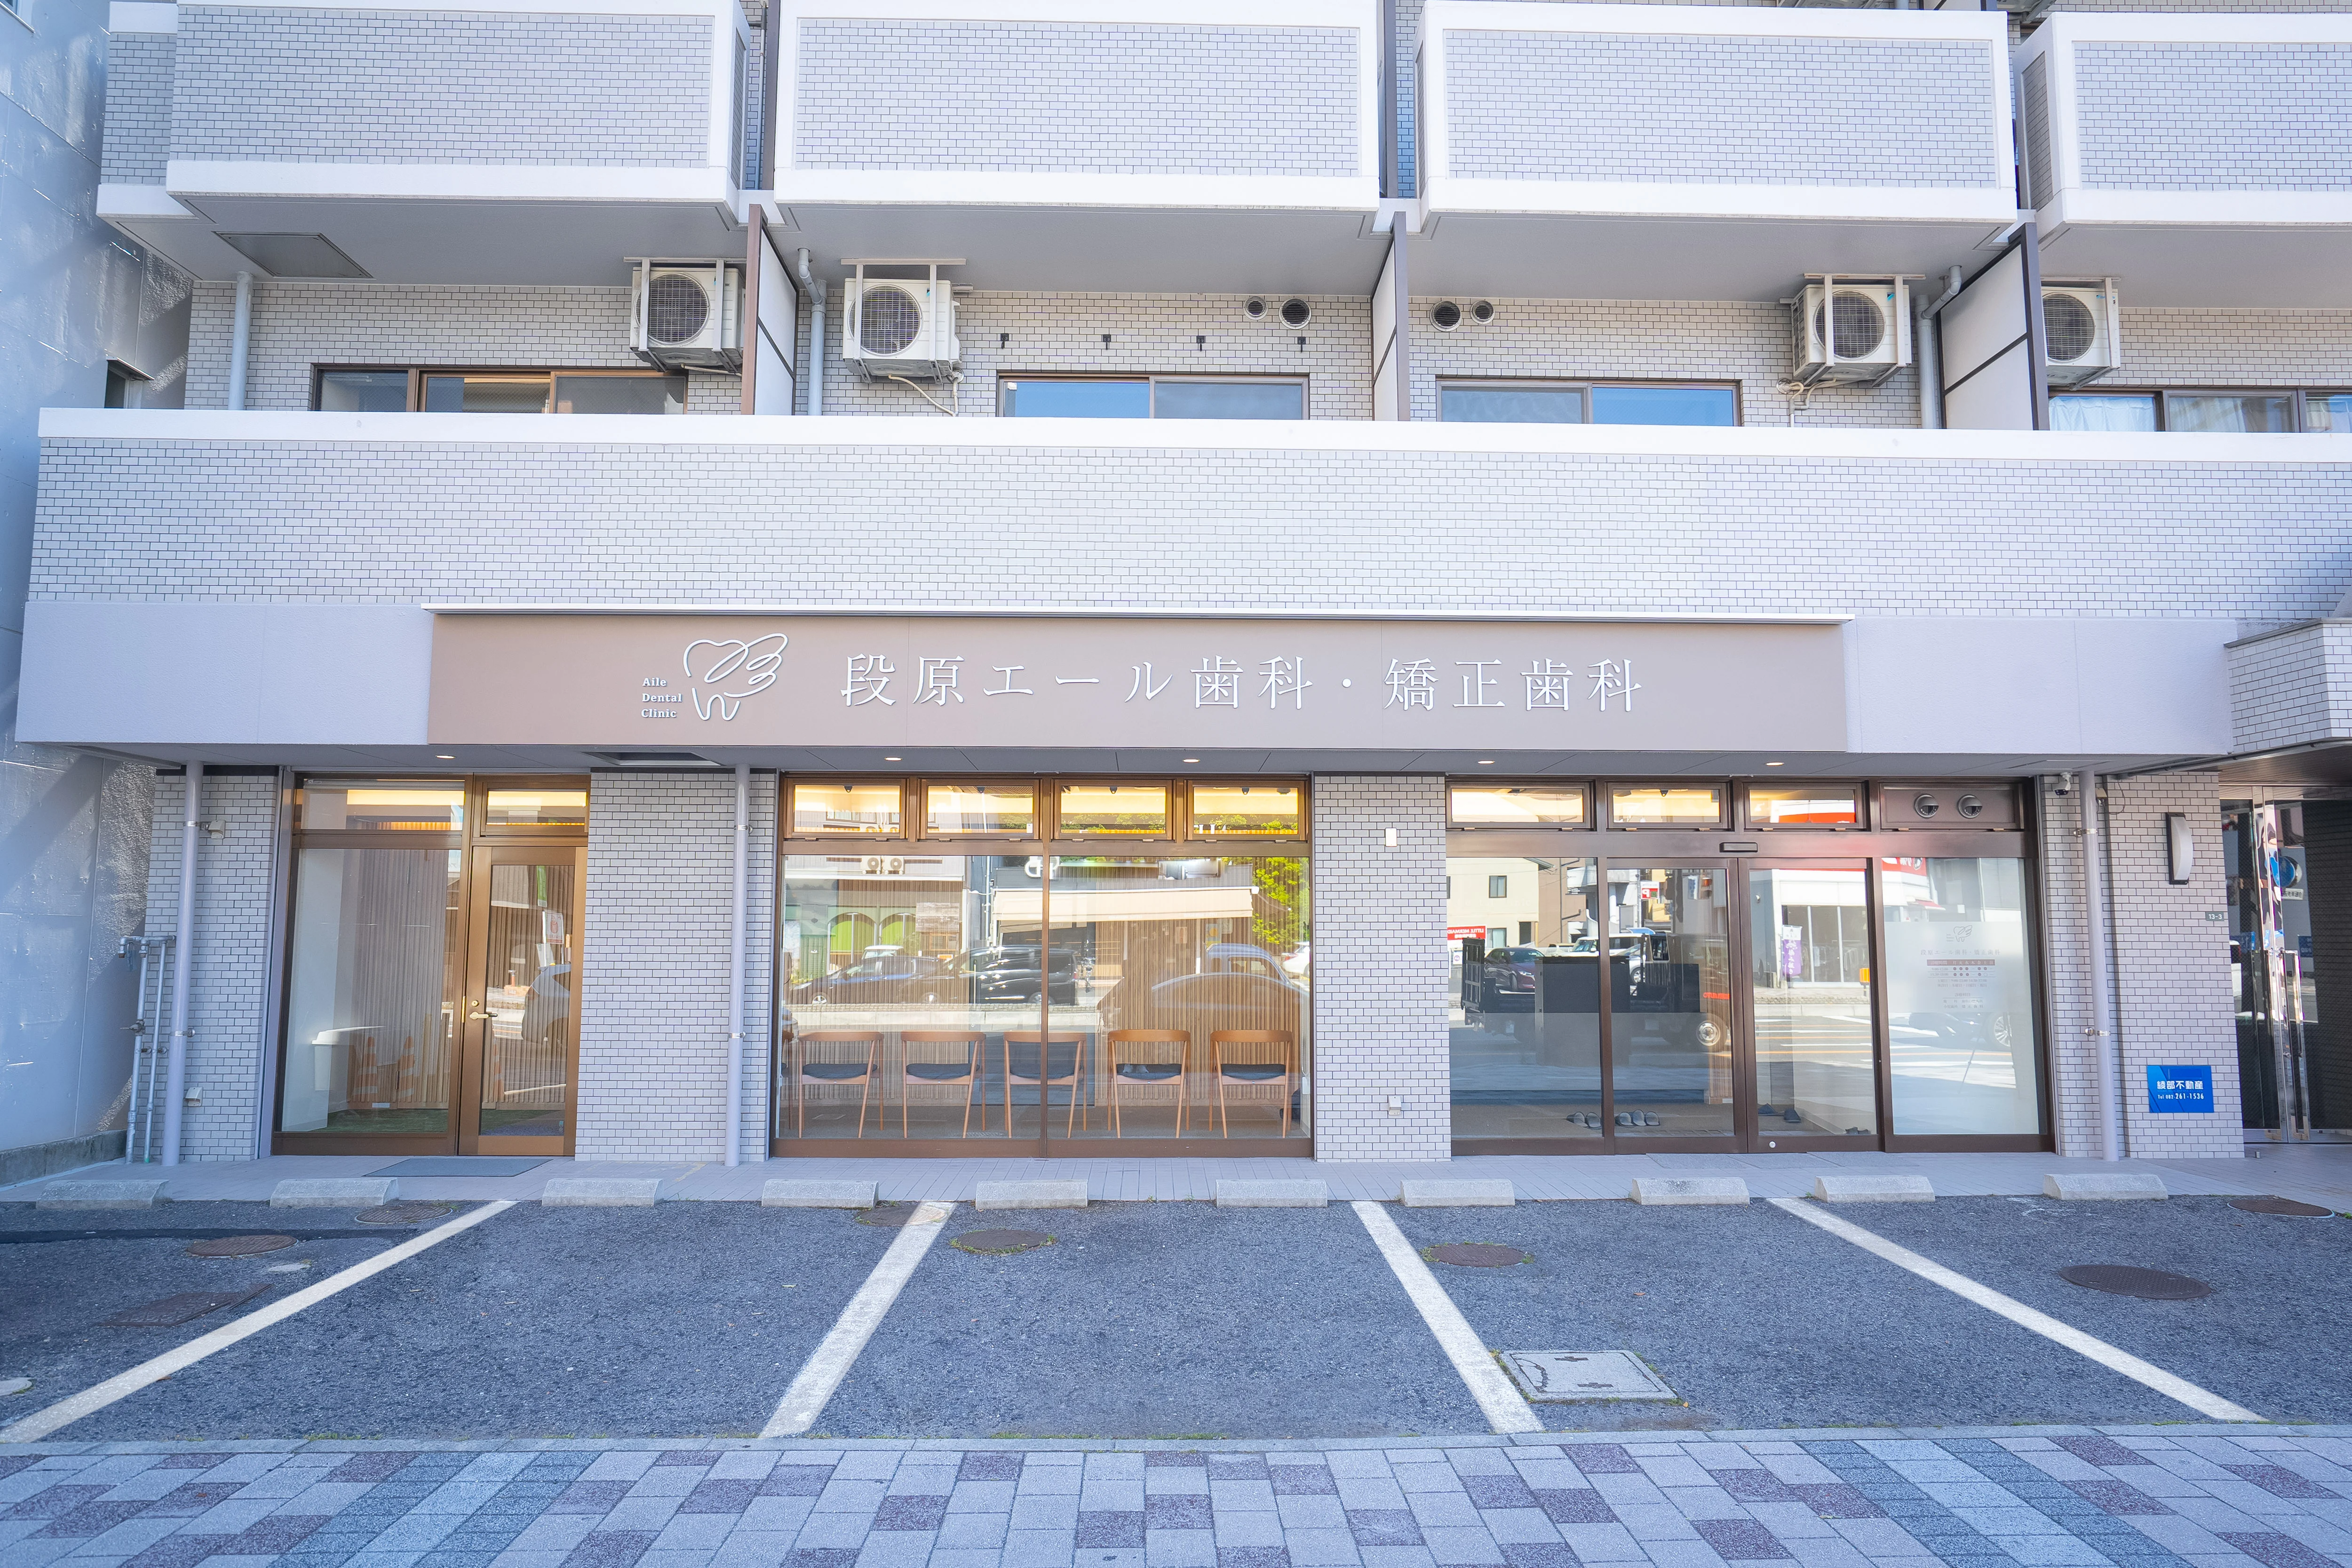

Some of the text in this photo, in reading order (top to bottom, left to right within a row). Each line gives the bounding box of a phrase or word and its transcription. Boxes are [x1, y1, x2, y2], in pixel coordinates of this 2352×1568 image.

[642, 677, 667, 687] Aile
[840, 653, 1642, 712] 段原エール歯科・矯正歯科
[642, 692, 682, 702] Dental
[641, 708, 677, 718] Clinic
[2157, 1081, 2203, 1090] 綾部不動産
